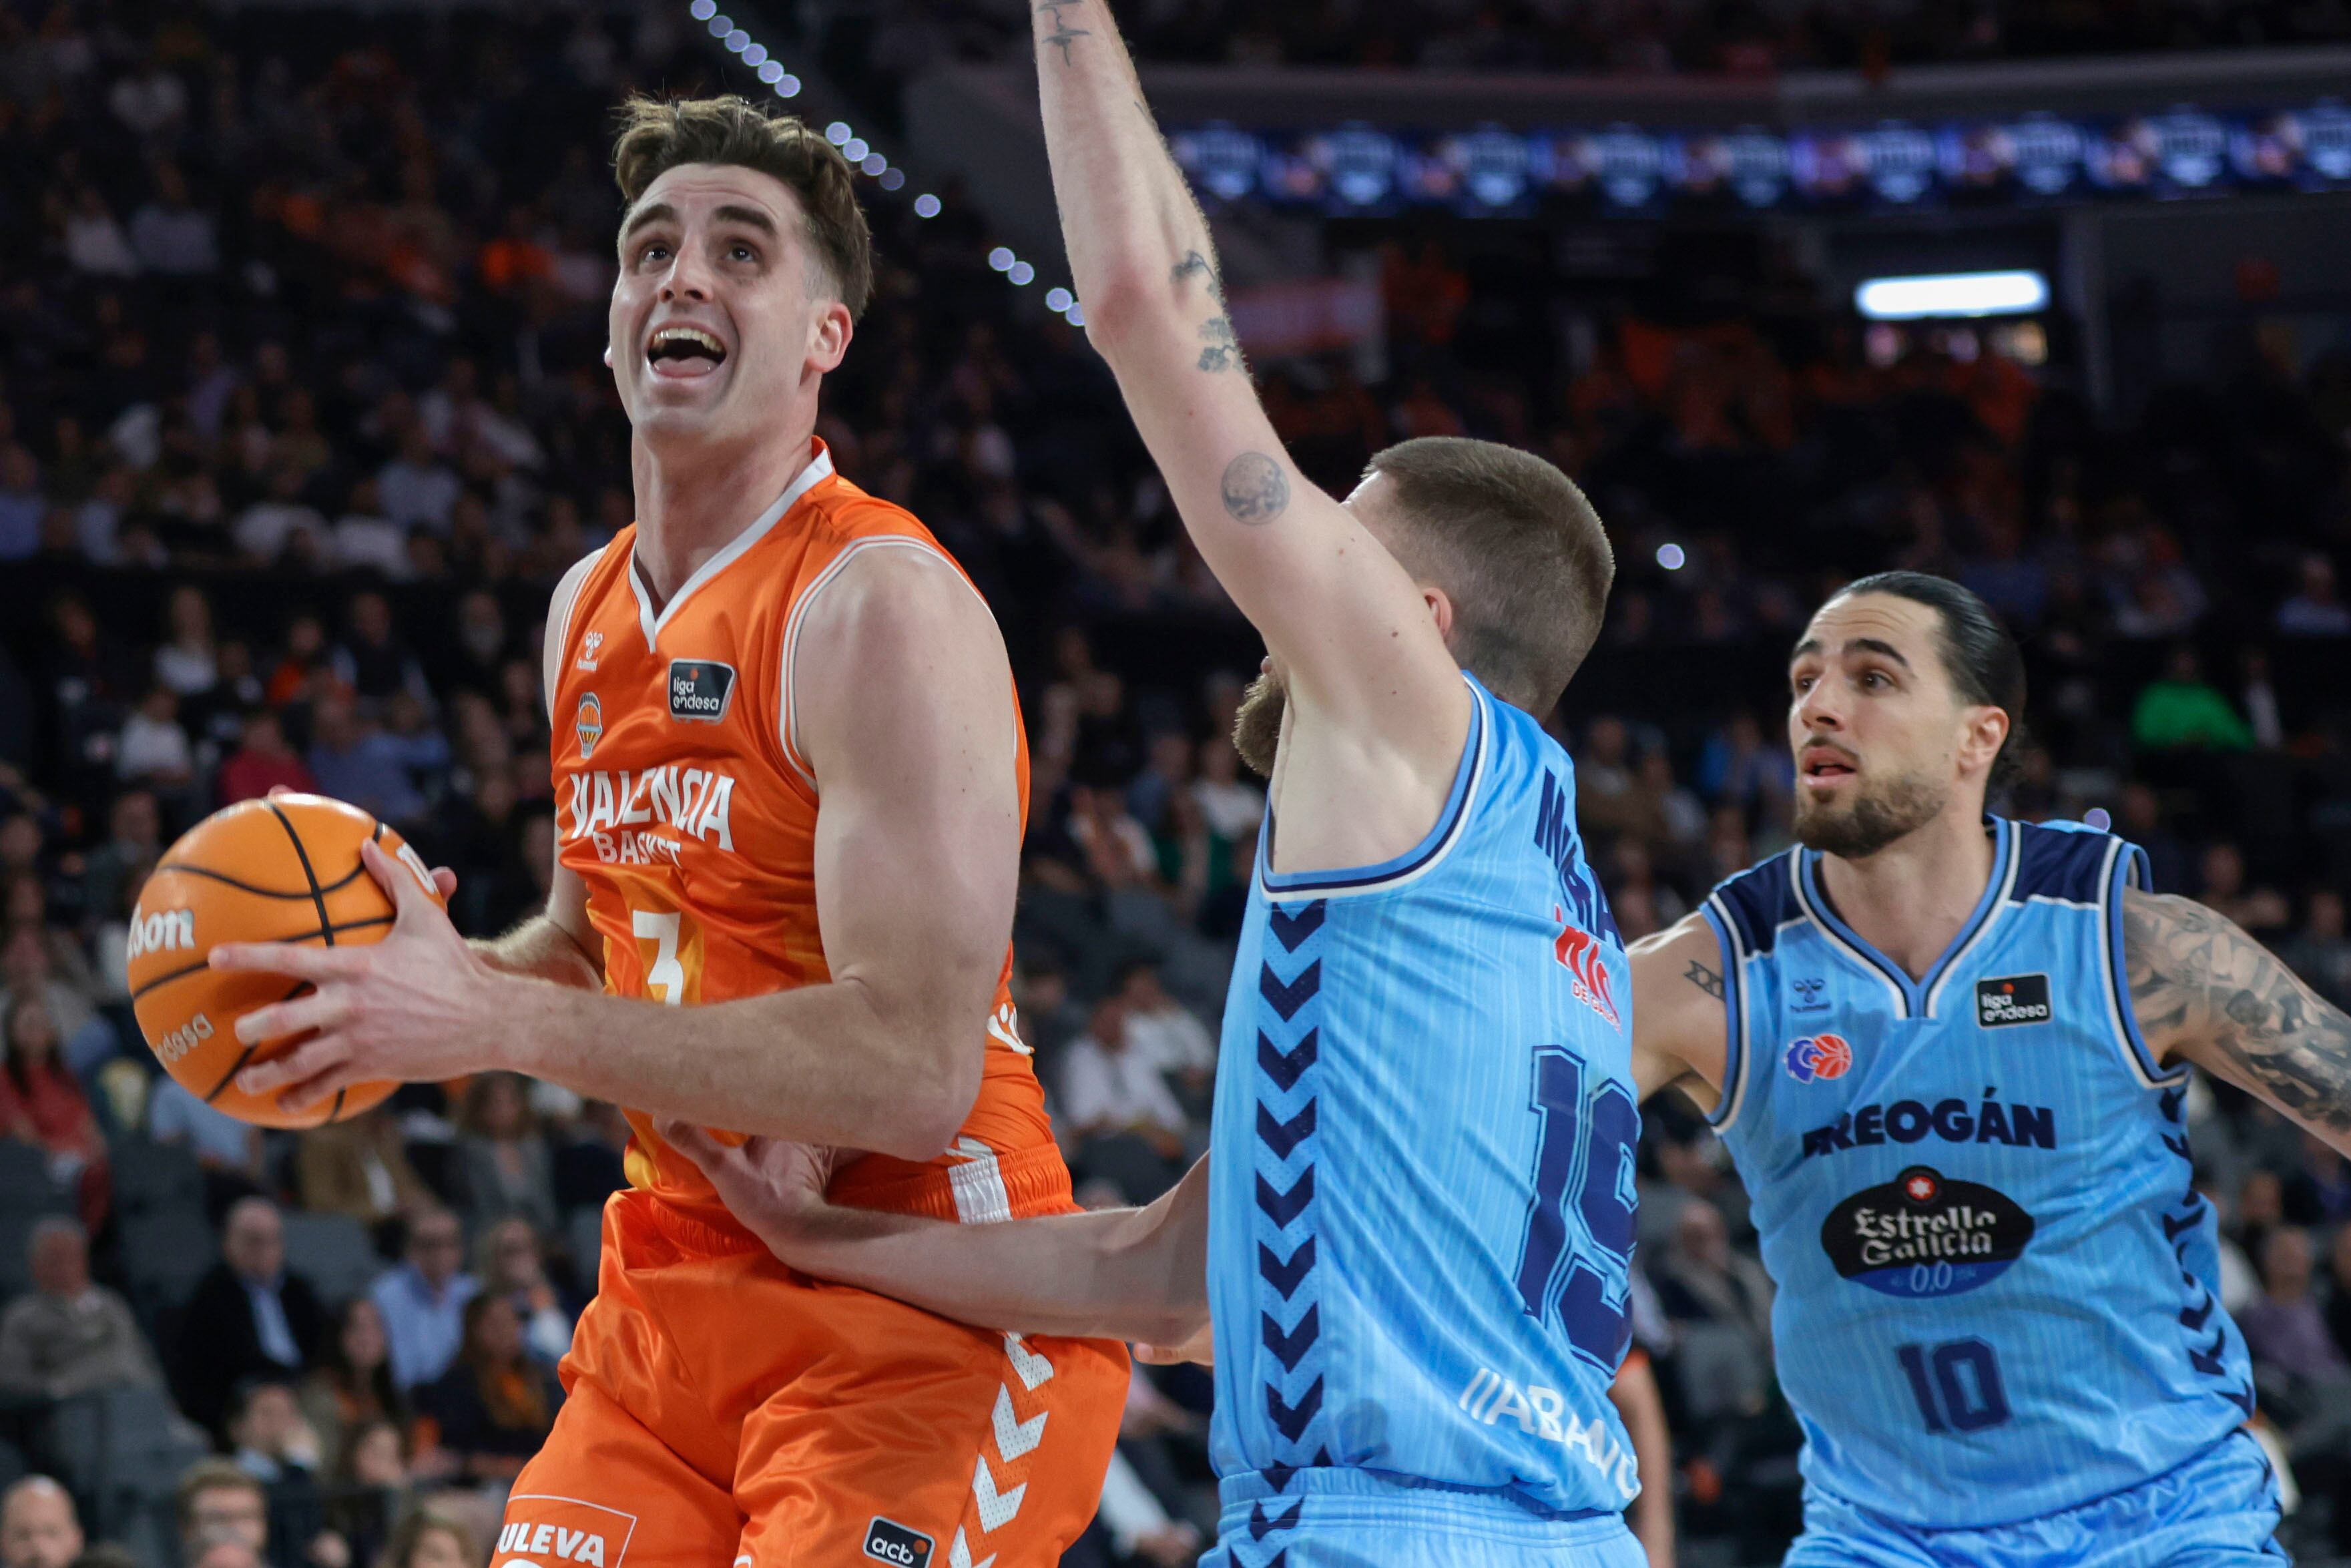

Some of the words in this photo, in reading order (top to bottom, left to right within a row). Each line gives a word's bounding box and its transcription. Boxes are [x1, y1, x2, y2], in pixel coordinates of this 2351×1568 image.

[673, 694, 720, 710] endesa
[674, 677, 695, 696] liga
[569, 766, 735, 852] VALENCIA
[593, 830, 683, 868] BASKET
[1981, 993, 2013, 1009] liga
[1983, 1003, 2047, 1022] endesa
[1854, 1206, 1997, 1239] Estrella
[1860, 1230, 1993, 1266] Galicia
[1894, 1336, 2013, 1435] 10
[497, 1522, 604, 1568] ULEVA
[871, 1537, 914, 1565] acb
